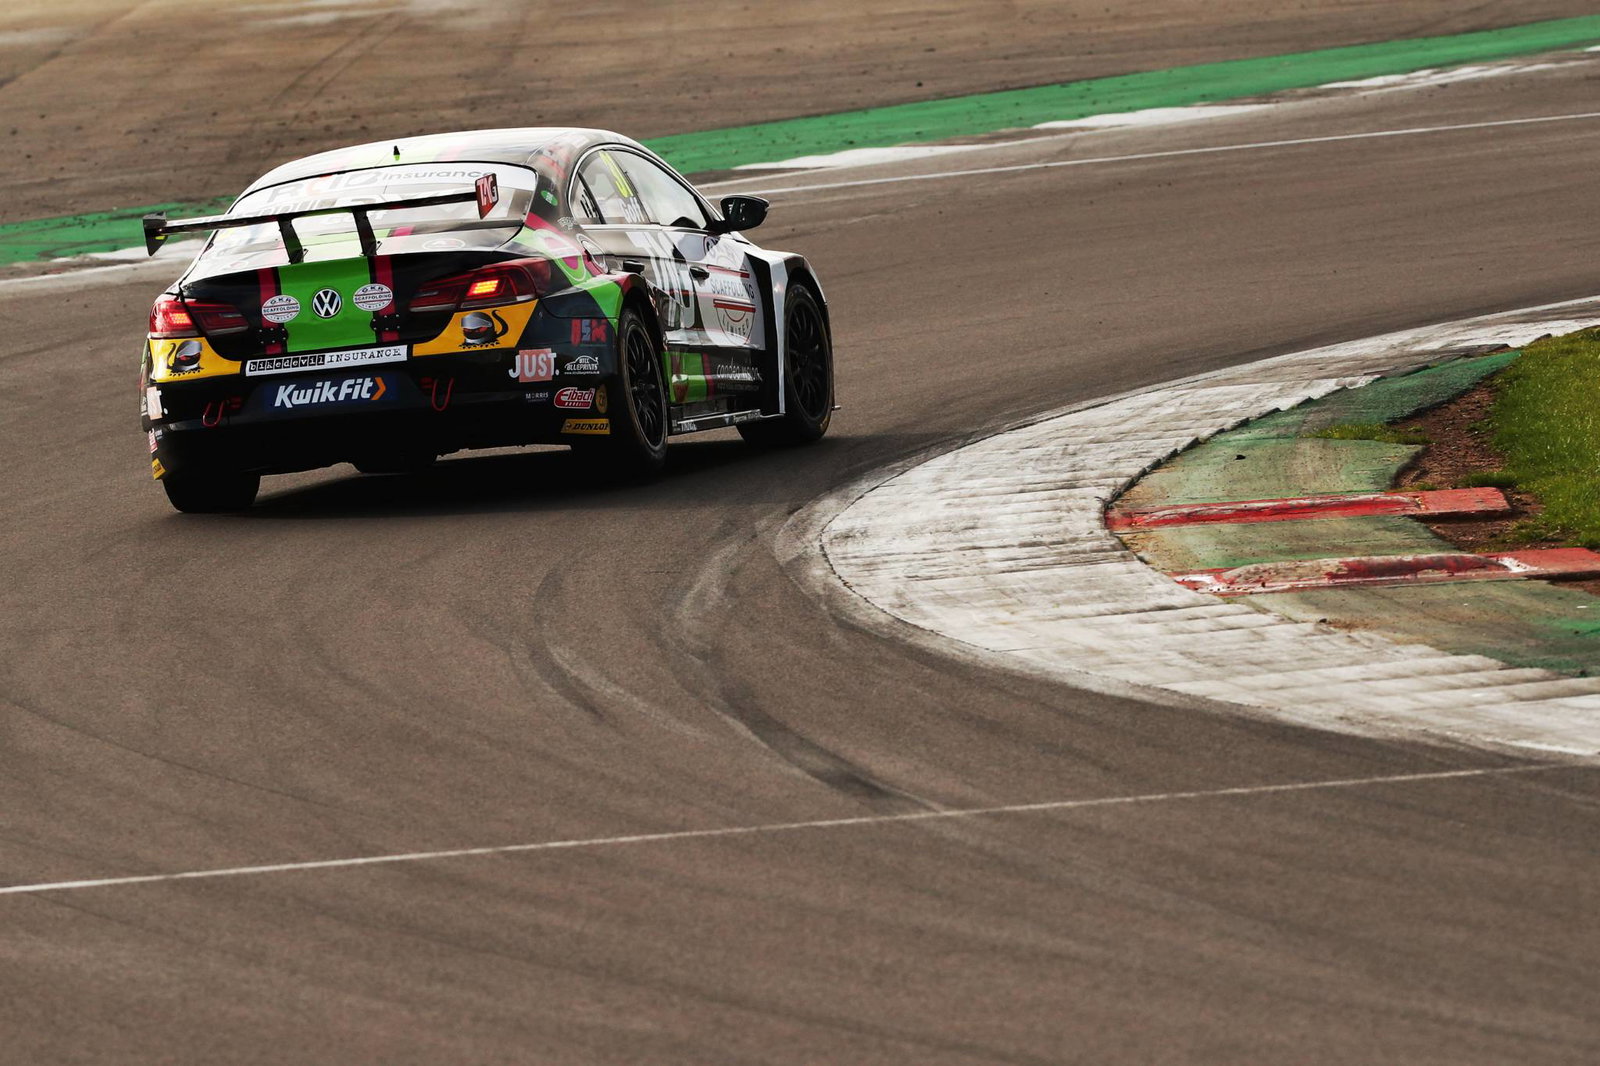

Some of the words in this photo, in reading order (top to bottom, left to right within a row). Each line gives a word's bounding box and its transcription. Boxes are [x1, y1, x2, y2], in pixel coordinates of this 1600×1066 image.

[355, 294, 391, 302] SCAFFOLDING
[263, 305, 299, 313] SCAFFOLDING
[249, 355, 325, 371] bikedevil
[327, 349, 401, 364] INSURANCE
[555, 388, 595, 402] Eibach
